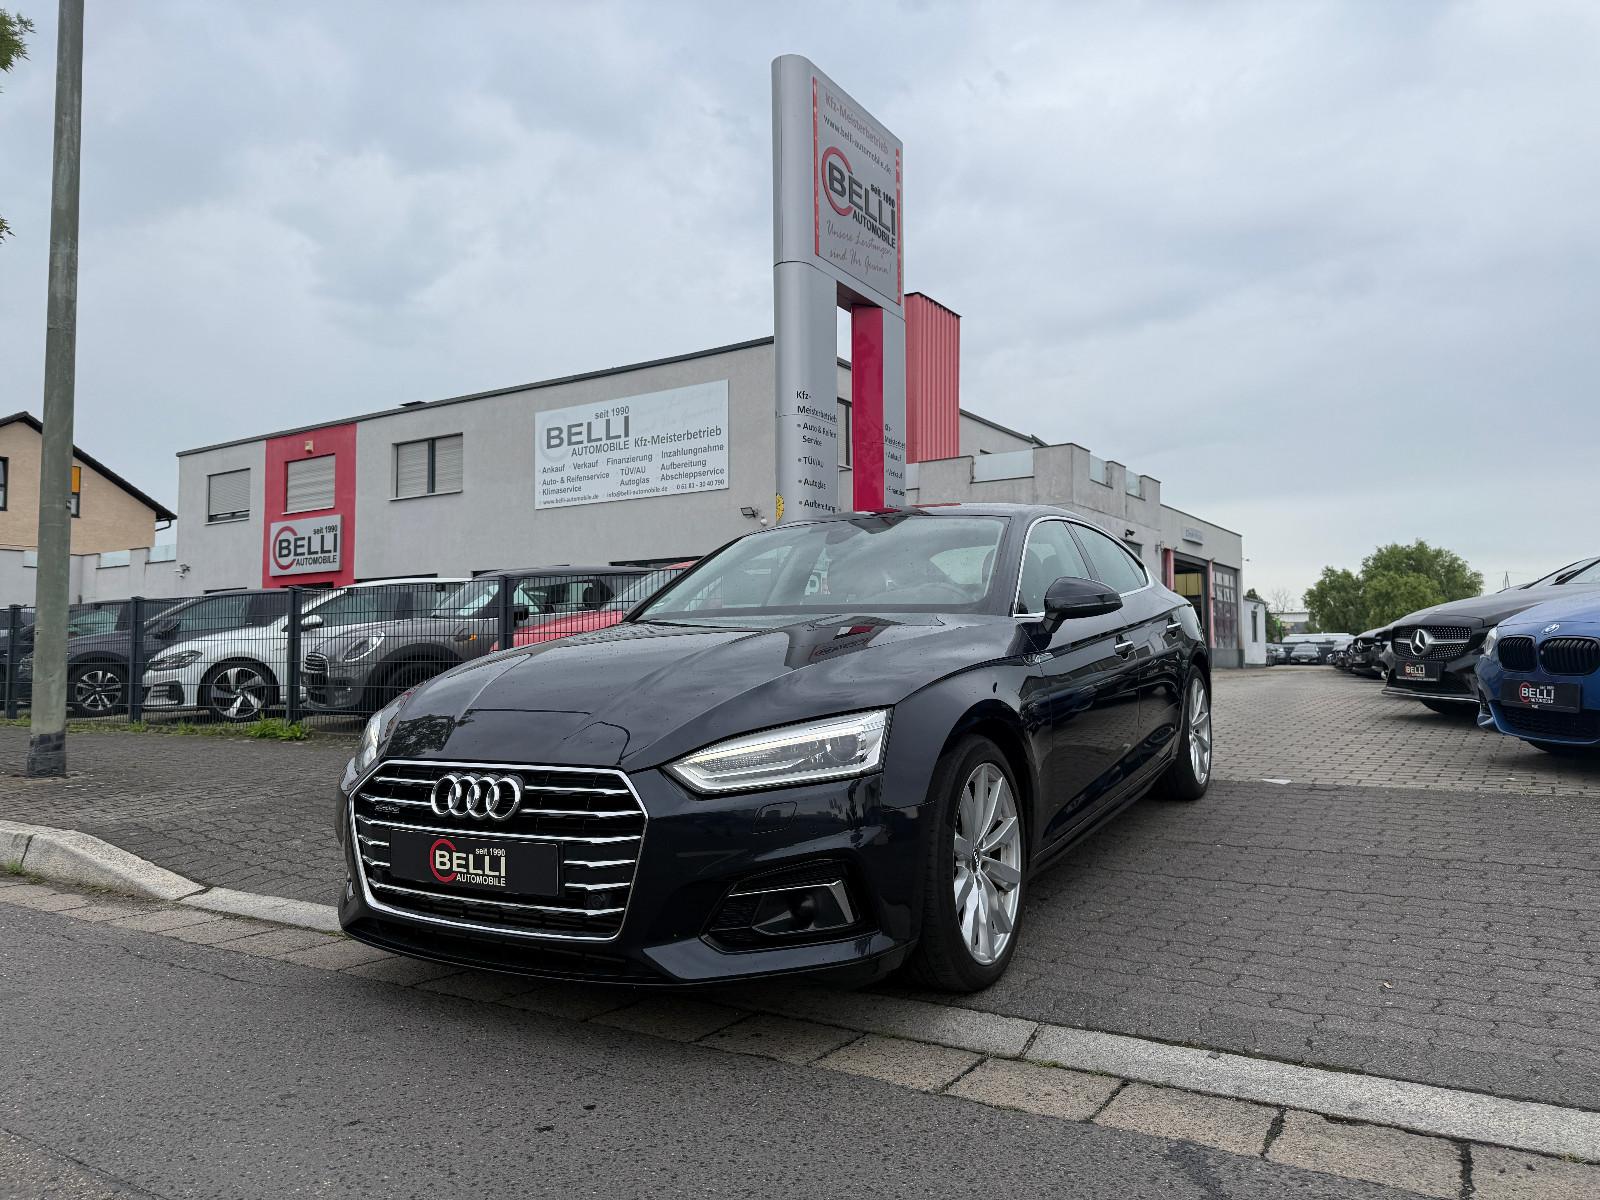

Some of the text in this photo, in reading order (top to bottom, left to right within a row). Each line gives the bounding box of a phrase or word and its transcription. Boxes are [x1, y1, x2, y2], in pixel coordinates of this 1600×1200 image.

[828, 161, 896, 235] BELLI
[853, 210, 896, 249] AUTOMOBILE
[796, 391, 811, 400] Kfz-
[595, 406, 630, 419] seit 1990
[546, 415, 630, 449] BELLI
[571, 425, 722, 457] AUTOMOBILE Kfz-Meisterbetrieb
[542, 443, 724, 474] Ankauf Verkauf Finanzierung Inzahlungnahme
[542, 477, 559, 486] Auto-
[567, 472, 609, 483] Reifenservice
[620, 466, 646, 475] TÜV/AU
[661, 459, 707, 471] Aufbereitung
[542, 468, 724, 496] Klimaservice Autoglas Abschleppservice
[313, 527, 323, 535] seit
[278, 533, 337, 558] BELLI
[296, 555, 337, 566] AUTOMOBILE
[1521, 688, 1554, 699] BELLI
[436, 850, 505, 876] BELLI
[490, 848, 505, 856] 1990
[456, 874, 506, 886] AUTOMOBILE
